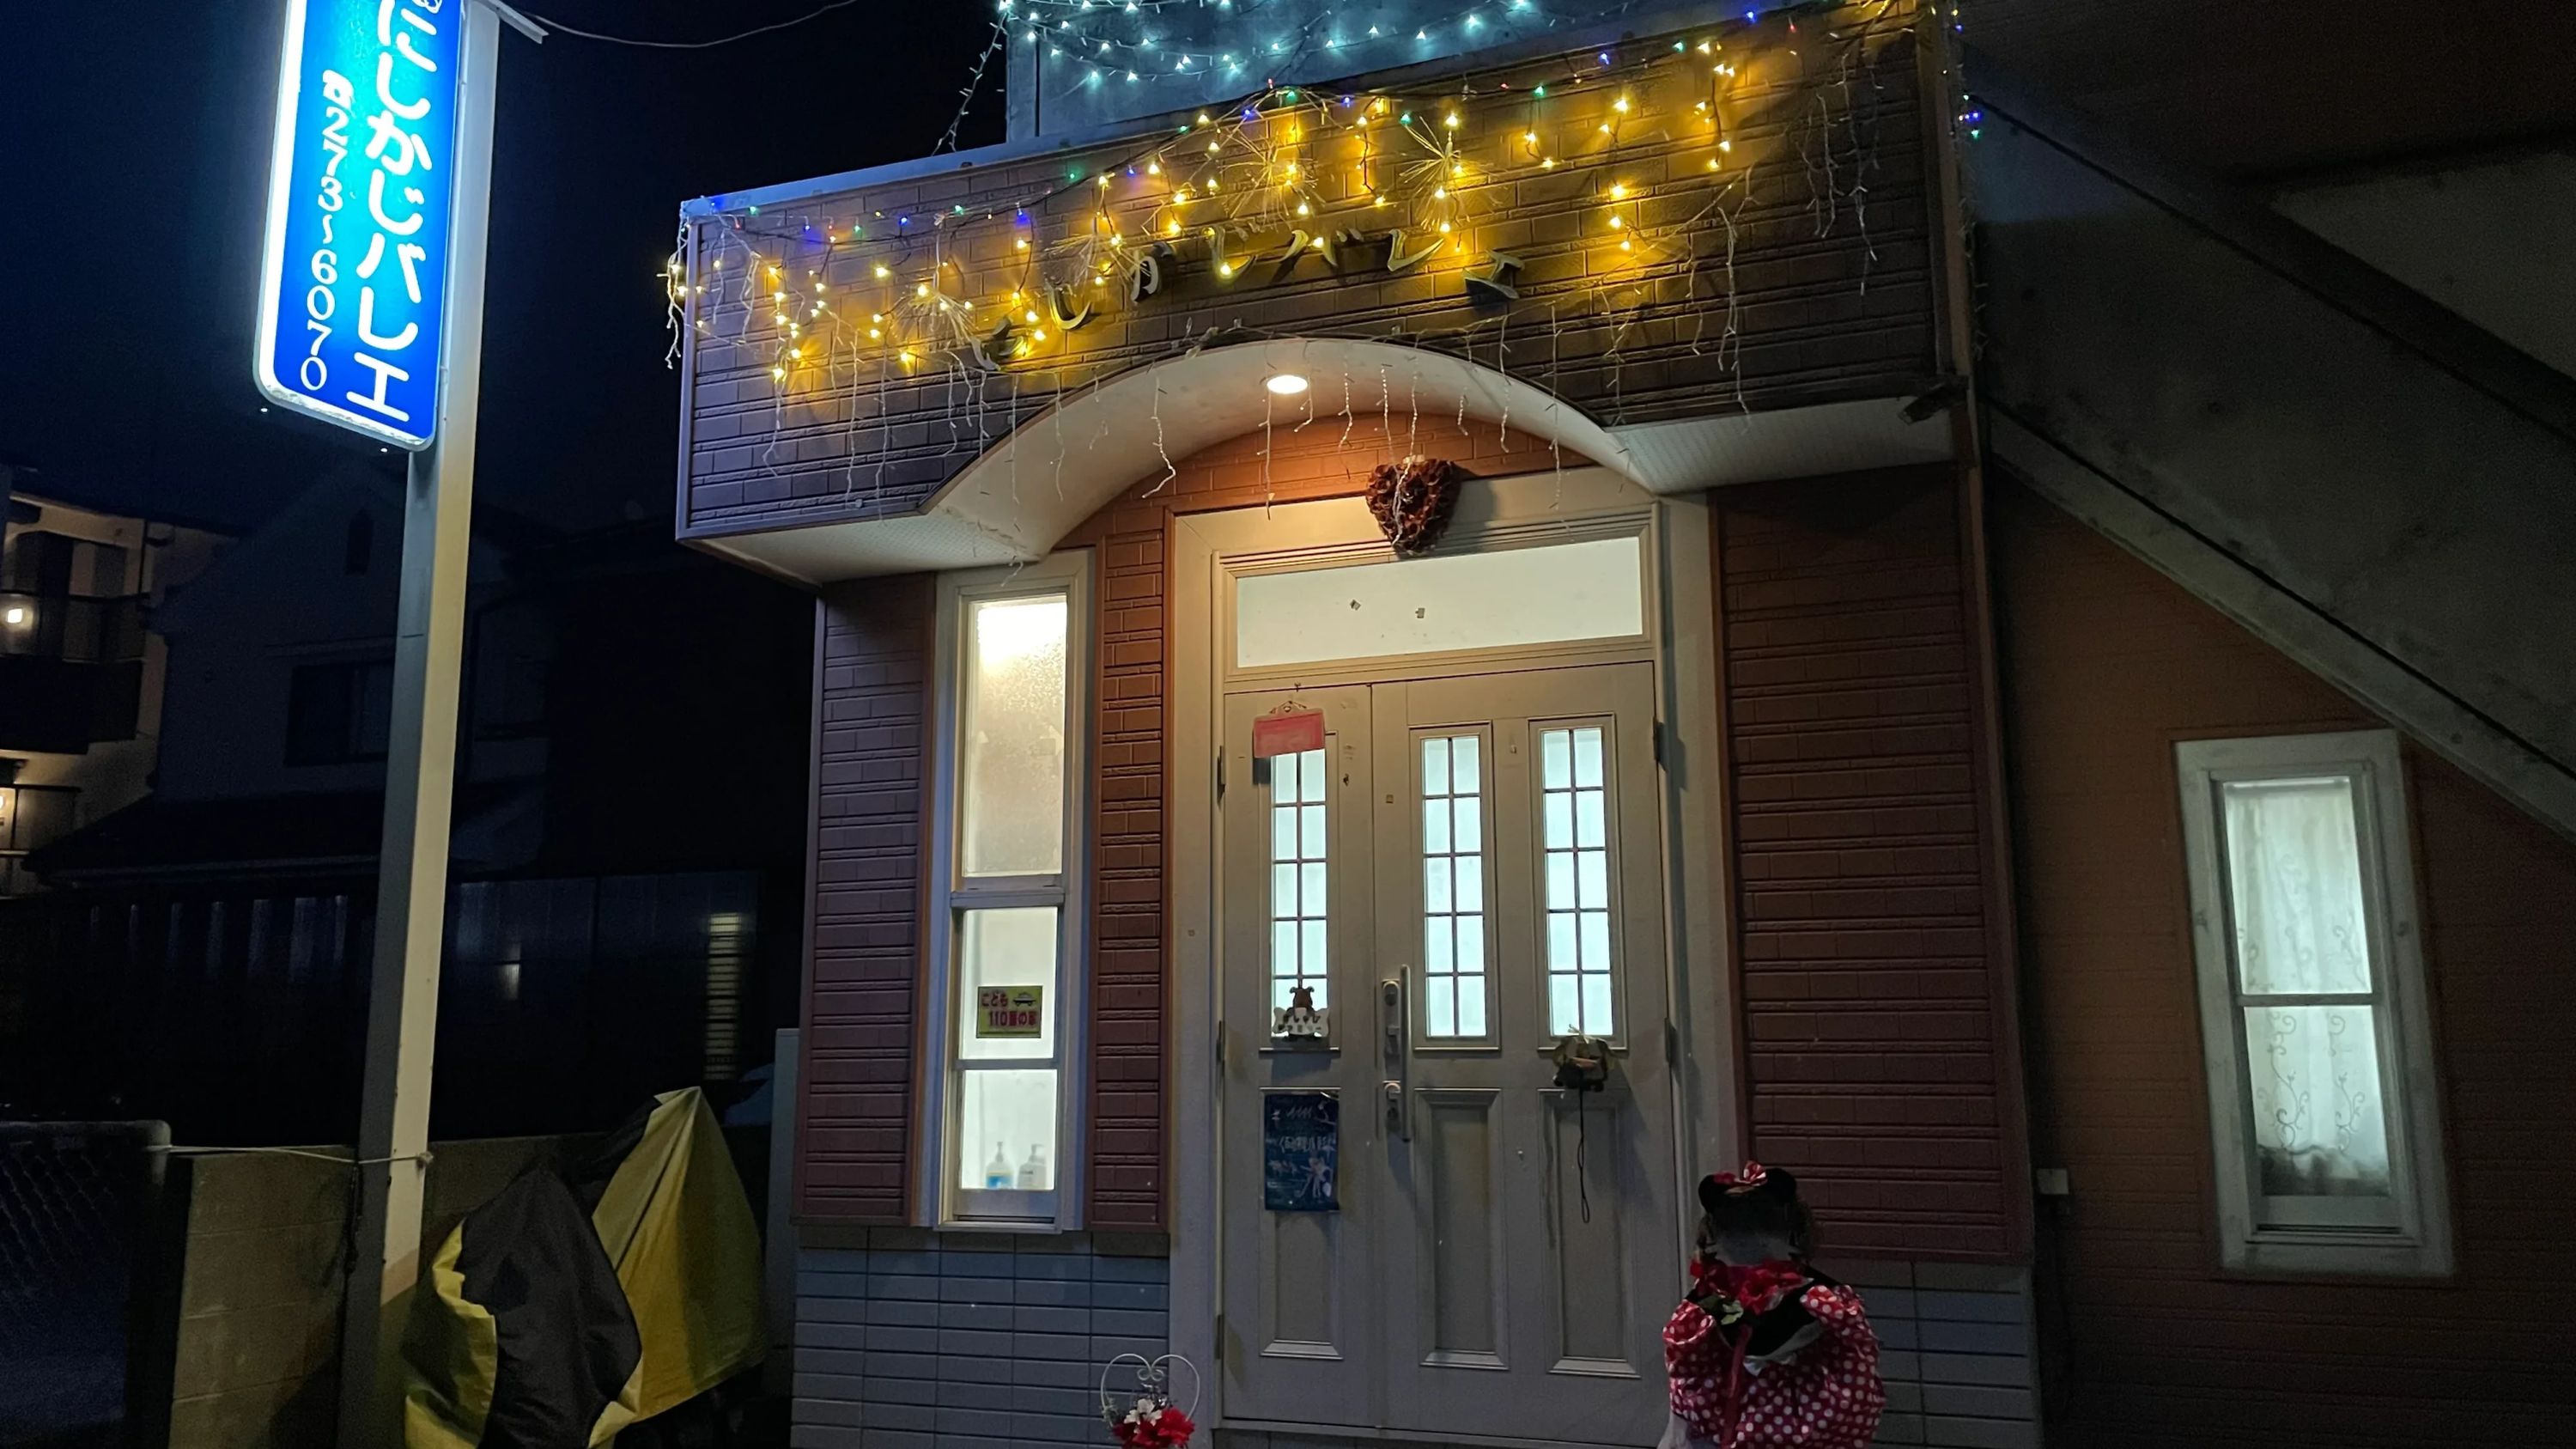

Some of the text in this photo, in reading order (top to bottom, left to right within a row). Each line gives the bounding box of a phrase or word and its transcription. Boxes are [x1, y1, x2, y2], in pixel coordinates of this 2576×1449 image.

[346, 0, 438, 422] にしかじバレエ
